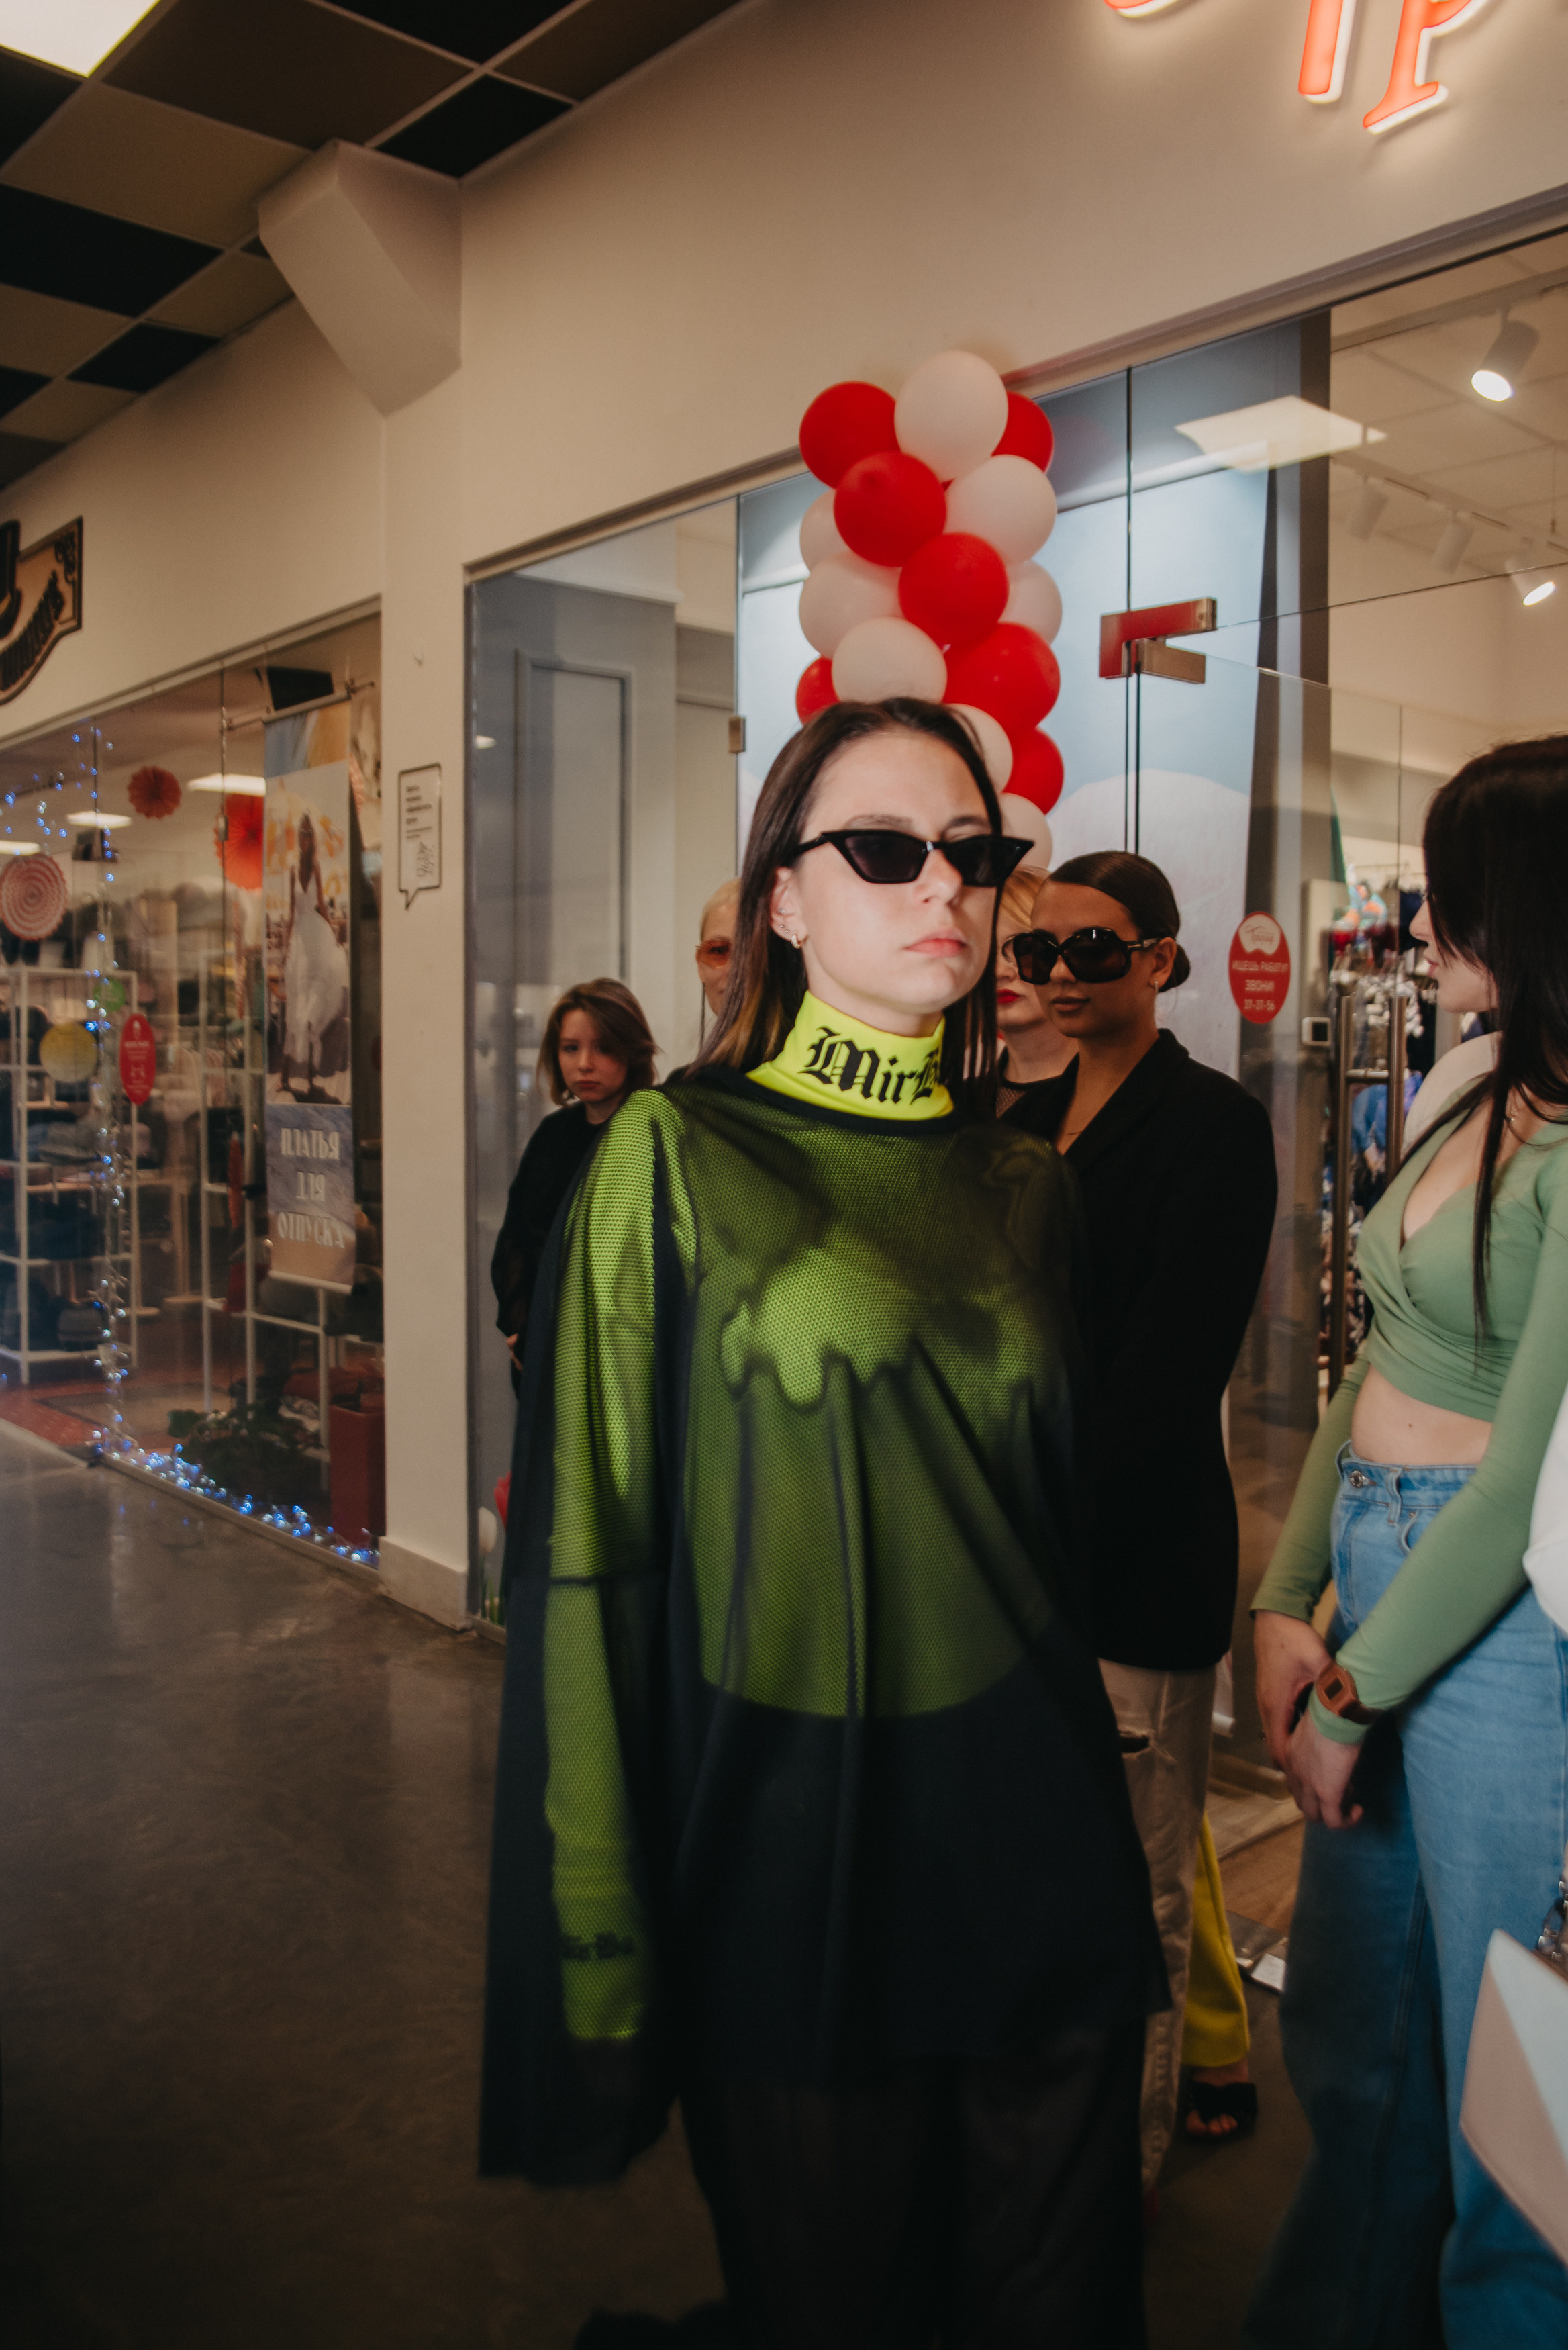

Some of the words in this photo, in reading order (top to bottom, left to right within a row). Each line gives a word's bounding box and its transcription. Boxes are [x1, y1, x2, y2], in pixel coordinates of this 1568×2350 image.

[281, 1127, 340, 1160] ПЛАТЬЯ
[295, 1171, 326, 1201] ДЛЯ
[277, 1211, 346, 1248] ОТПУСКА
